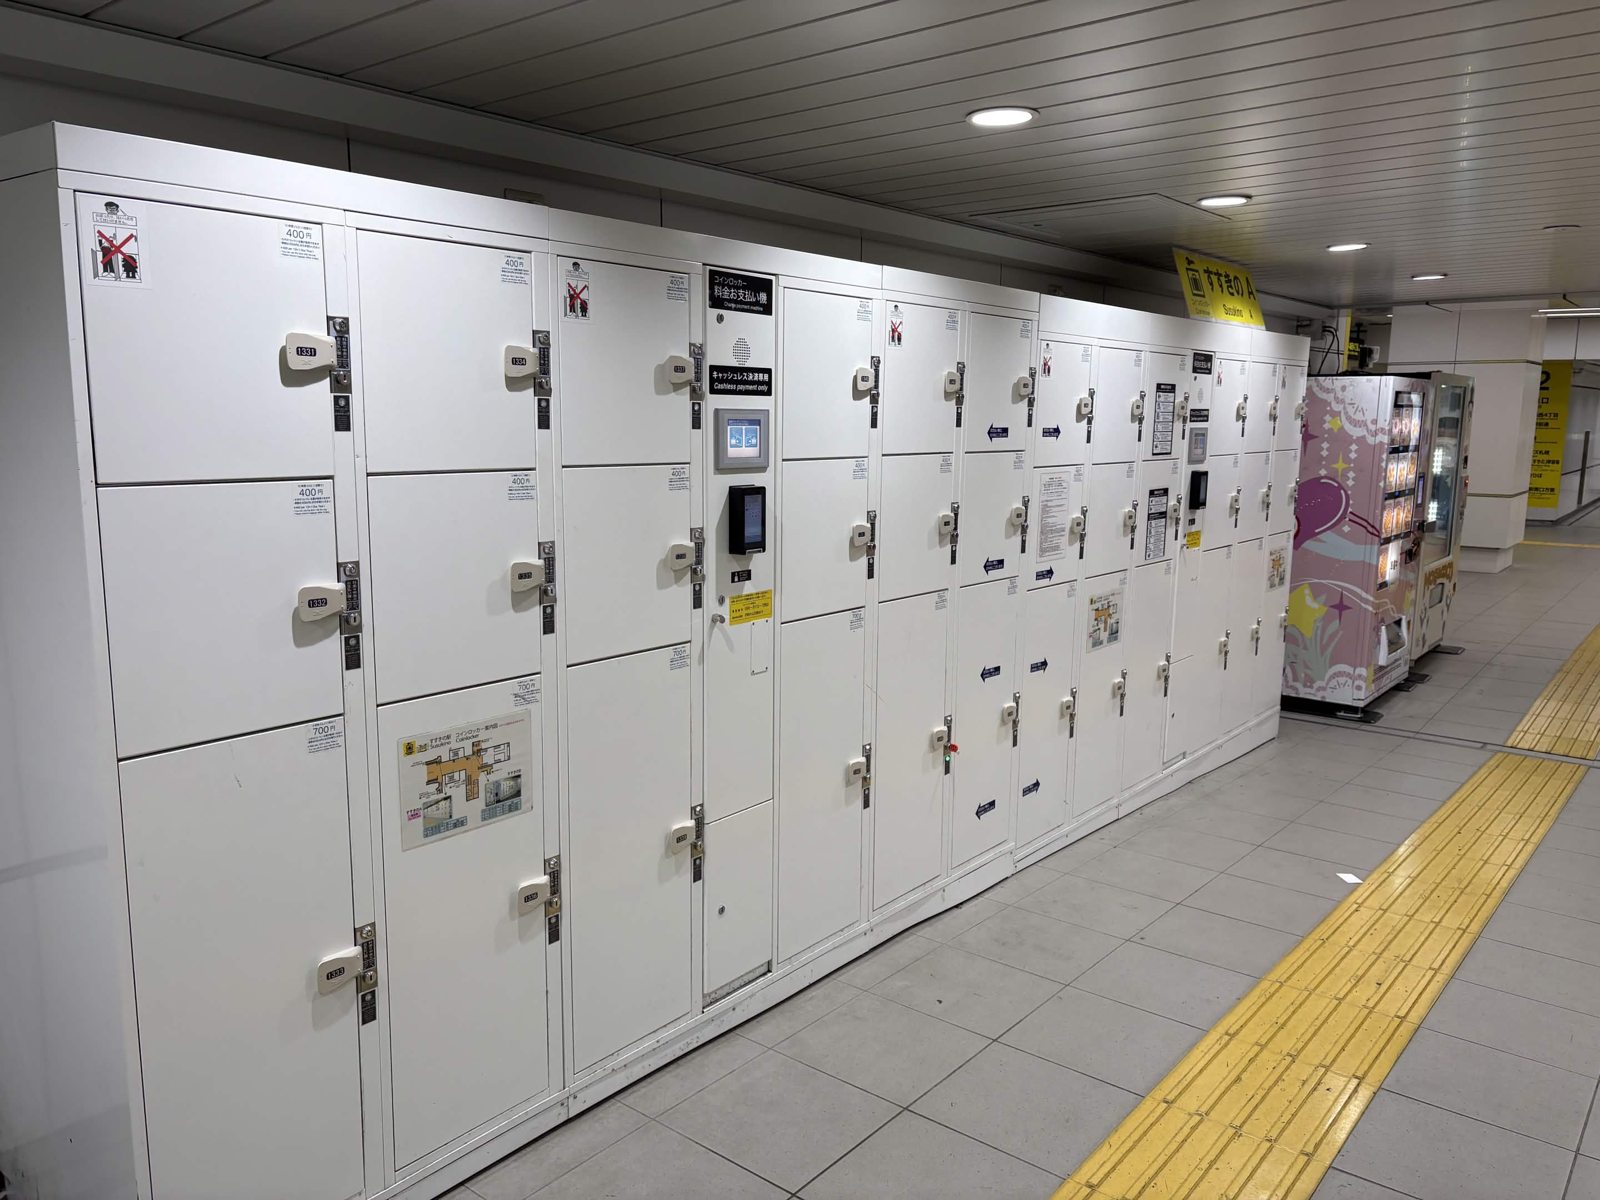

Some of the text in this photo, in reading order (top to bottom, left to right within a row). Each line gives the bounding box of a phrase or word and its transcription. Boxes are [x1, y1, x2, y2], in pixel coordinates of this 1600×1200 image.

[286, 228, 312, 240] 400円
[714, 275, 748, 287] コインロッカー
[1203, 266, 1257, 301] すすきの A
[714, 285, 768, 304] 料金お支払い機
[297, 347, 315, 356] 1331
[712, 370, 769, 382] キャッシュレス決済専用
[1540, 370, 1551, 391] 2
[713, 381, 769, 392] Cashless payment only
[298, 488, 324, 497] 400円
[310, 598, 327, 608] 1332
[312, 725, 336, 735] 700円
[430, 741, 452, 750] Susukino
